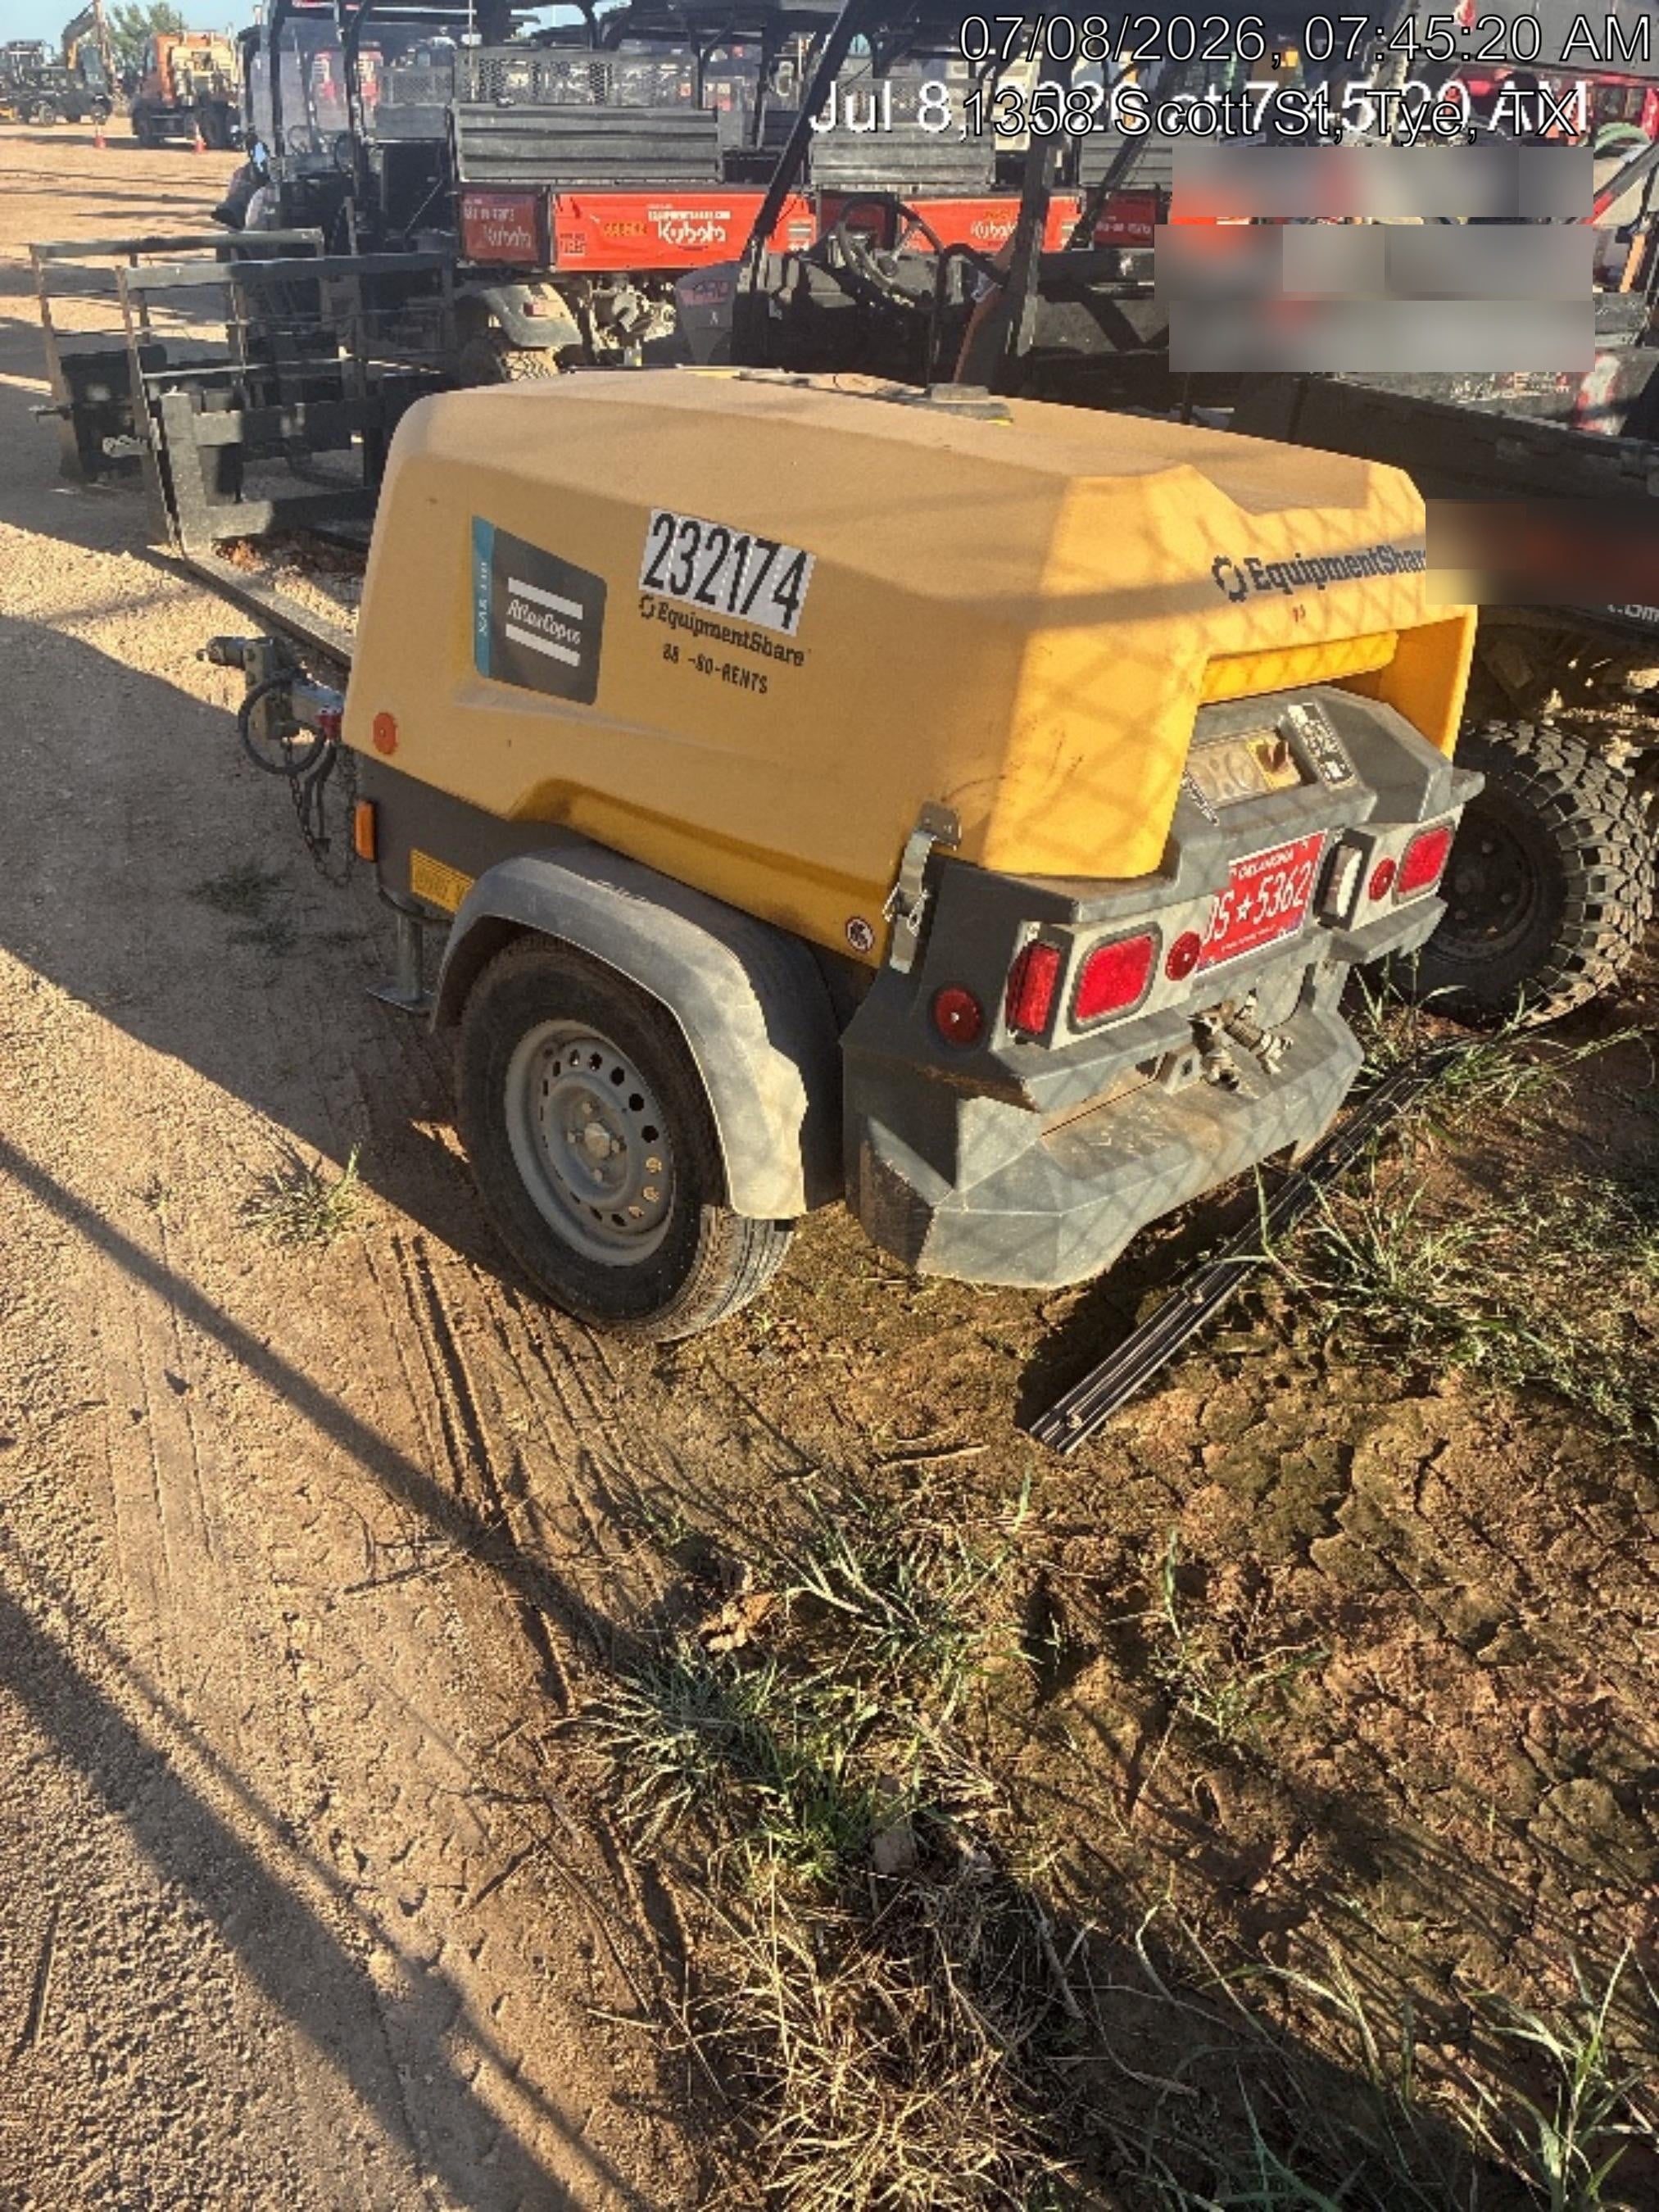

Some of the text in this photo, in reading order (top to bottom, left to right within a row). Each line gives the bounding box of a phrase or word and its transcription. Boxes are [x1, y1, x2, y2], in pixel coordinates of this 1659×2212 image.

[657, 220, 727, 244] Kubota
[642, 513, 808, 629] 232174
[656, 602, 805, 666] EquipmentShare
